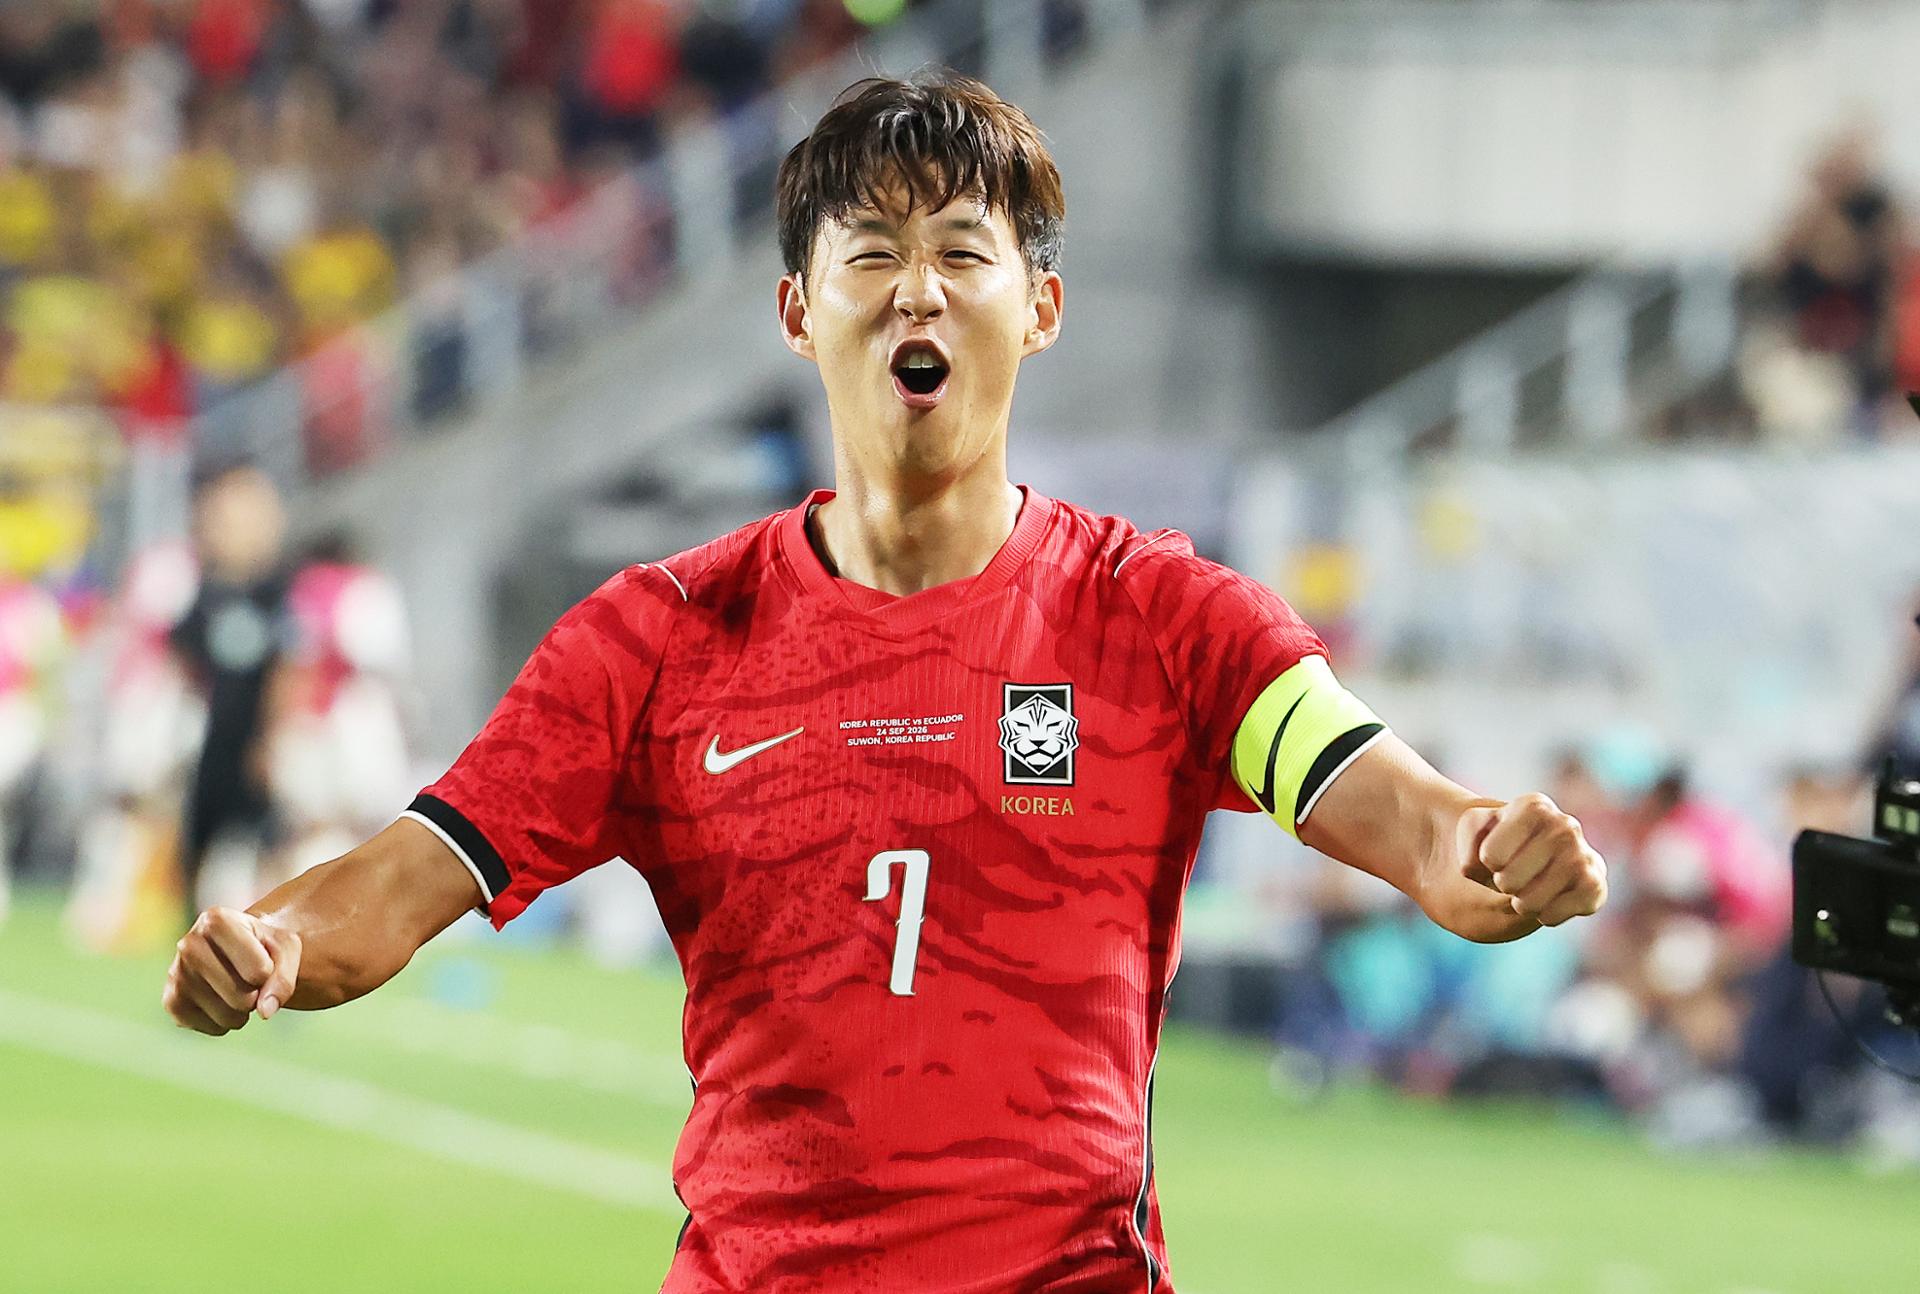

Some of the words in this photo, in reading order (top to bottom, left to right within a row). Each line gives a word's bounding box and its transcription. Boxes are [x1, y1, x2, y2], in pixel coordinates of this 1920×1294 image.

[840, 721, 868, 729] KOREA
[870, 718, 911, 727] REPUBLIC
[924, 714, 964, 725] ECUADOR
[876, 728, 887, 736] 24
[889, 727, 905, 735] SEP
[907, 726, 928, 734] 2026
[847, 737, 884, 746] SUWON,
[885, 735, 913, 744] KOREA
[915, 732, 956, 742] REPUBLIC
[1001, 795, 1075, 816] KOREA
[862, 849, 930, 995] 7
